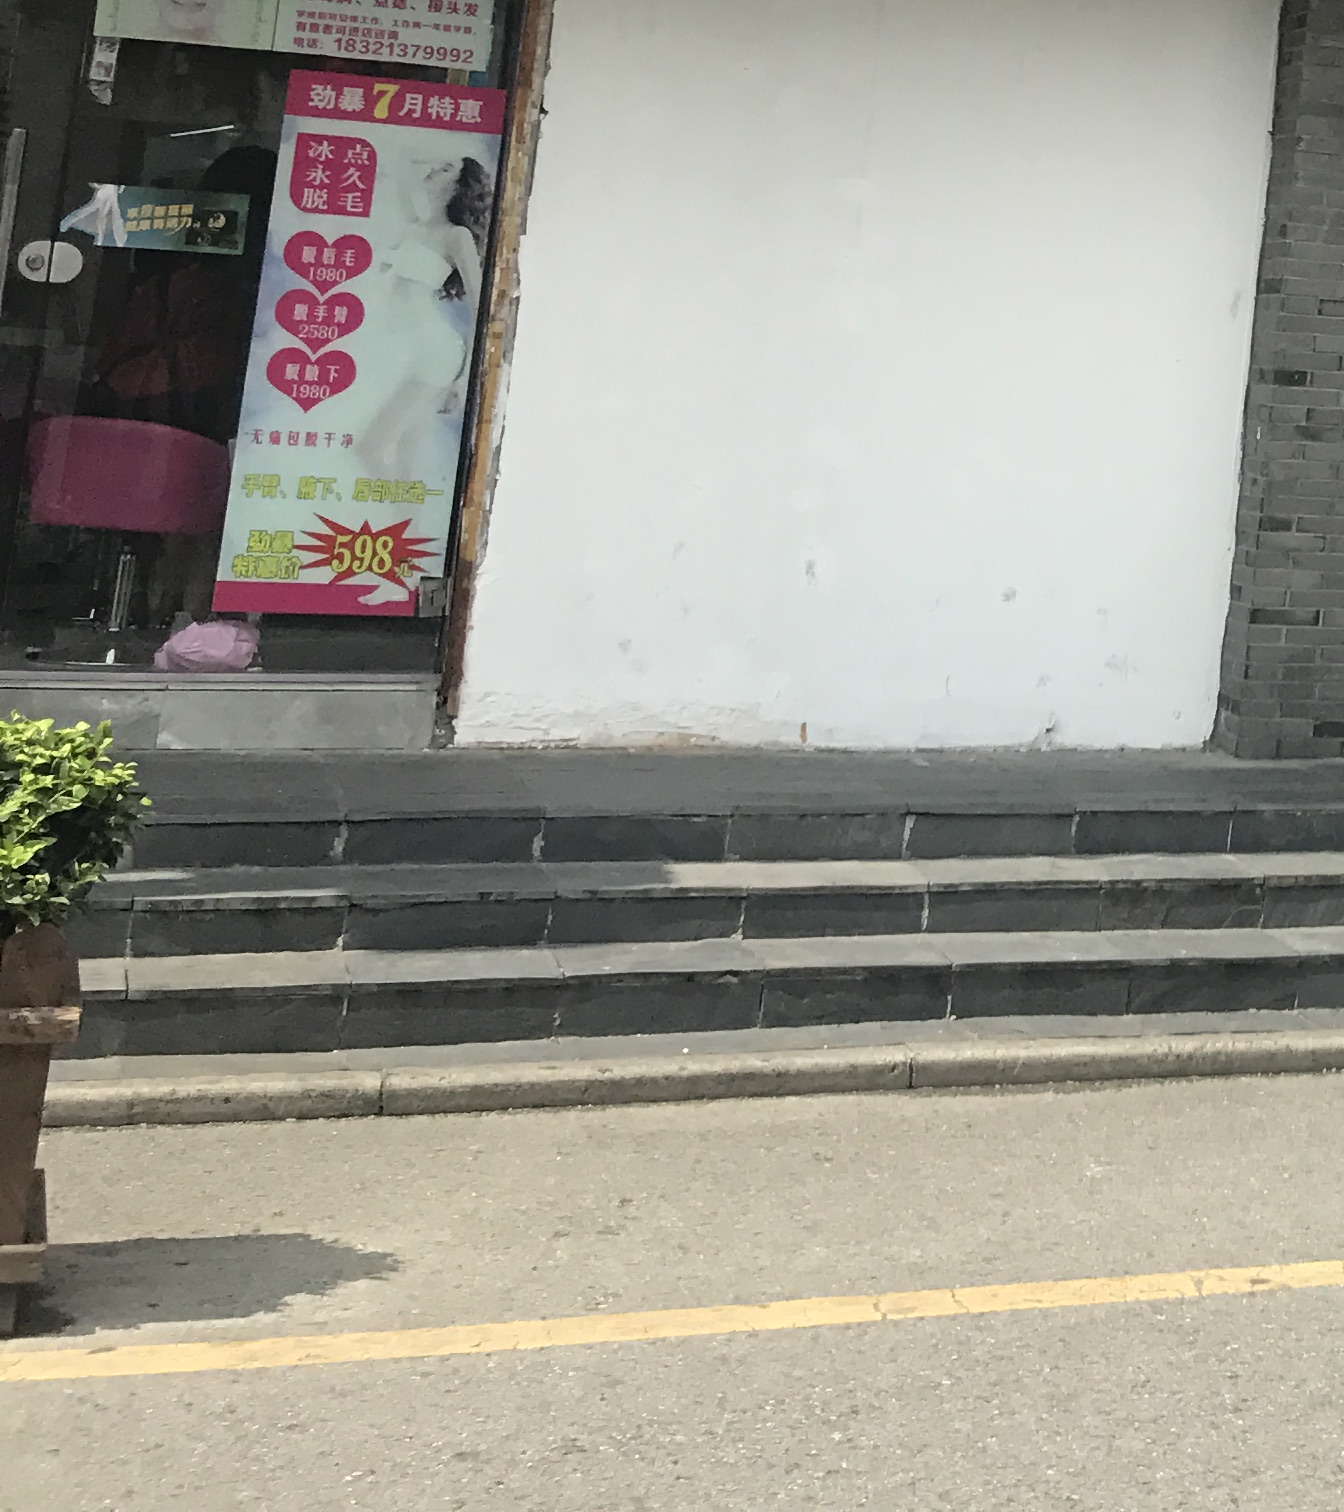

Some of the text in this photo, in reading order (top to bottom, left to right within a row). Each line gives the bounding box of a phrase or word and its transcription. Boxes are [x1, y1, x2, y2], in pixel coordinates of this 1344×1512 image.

[334, 38, 474, 64] 18321379992
[308, 82, 484, 123] 劲暴7月特惠
[308, 267, 347, 283] 1980
[298, 324, 339, 340] 2580
[290, 383, 330, 399] 1980
[330, 534, 394, 574] 598
